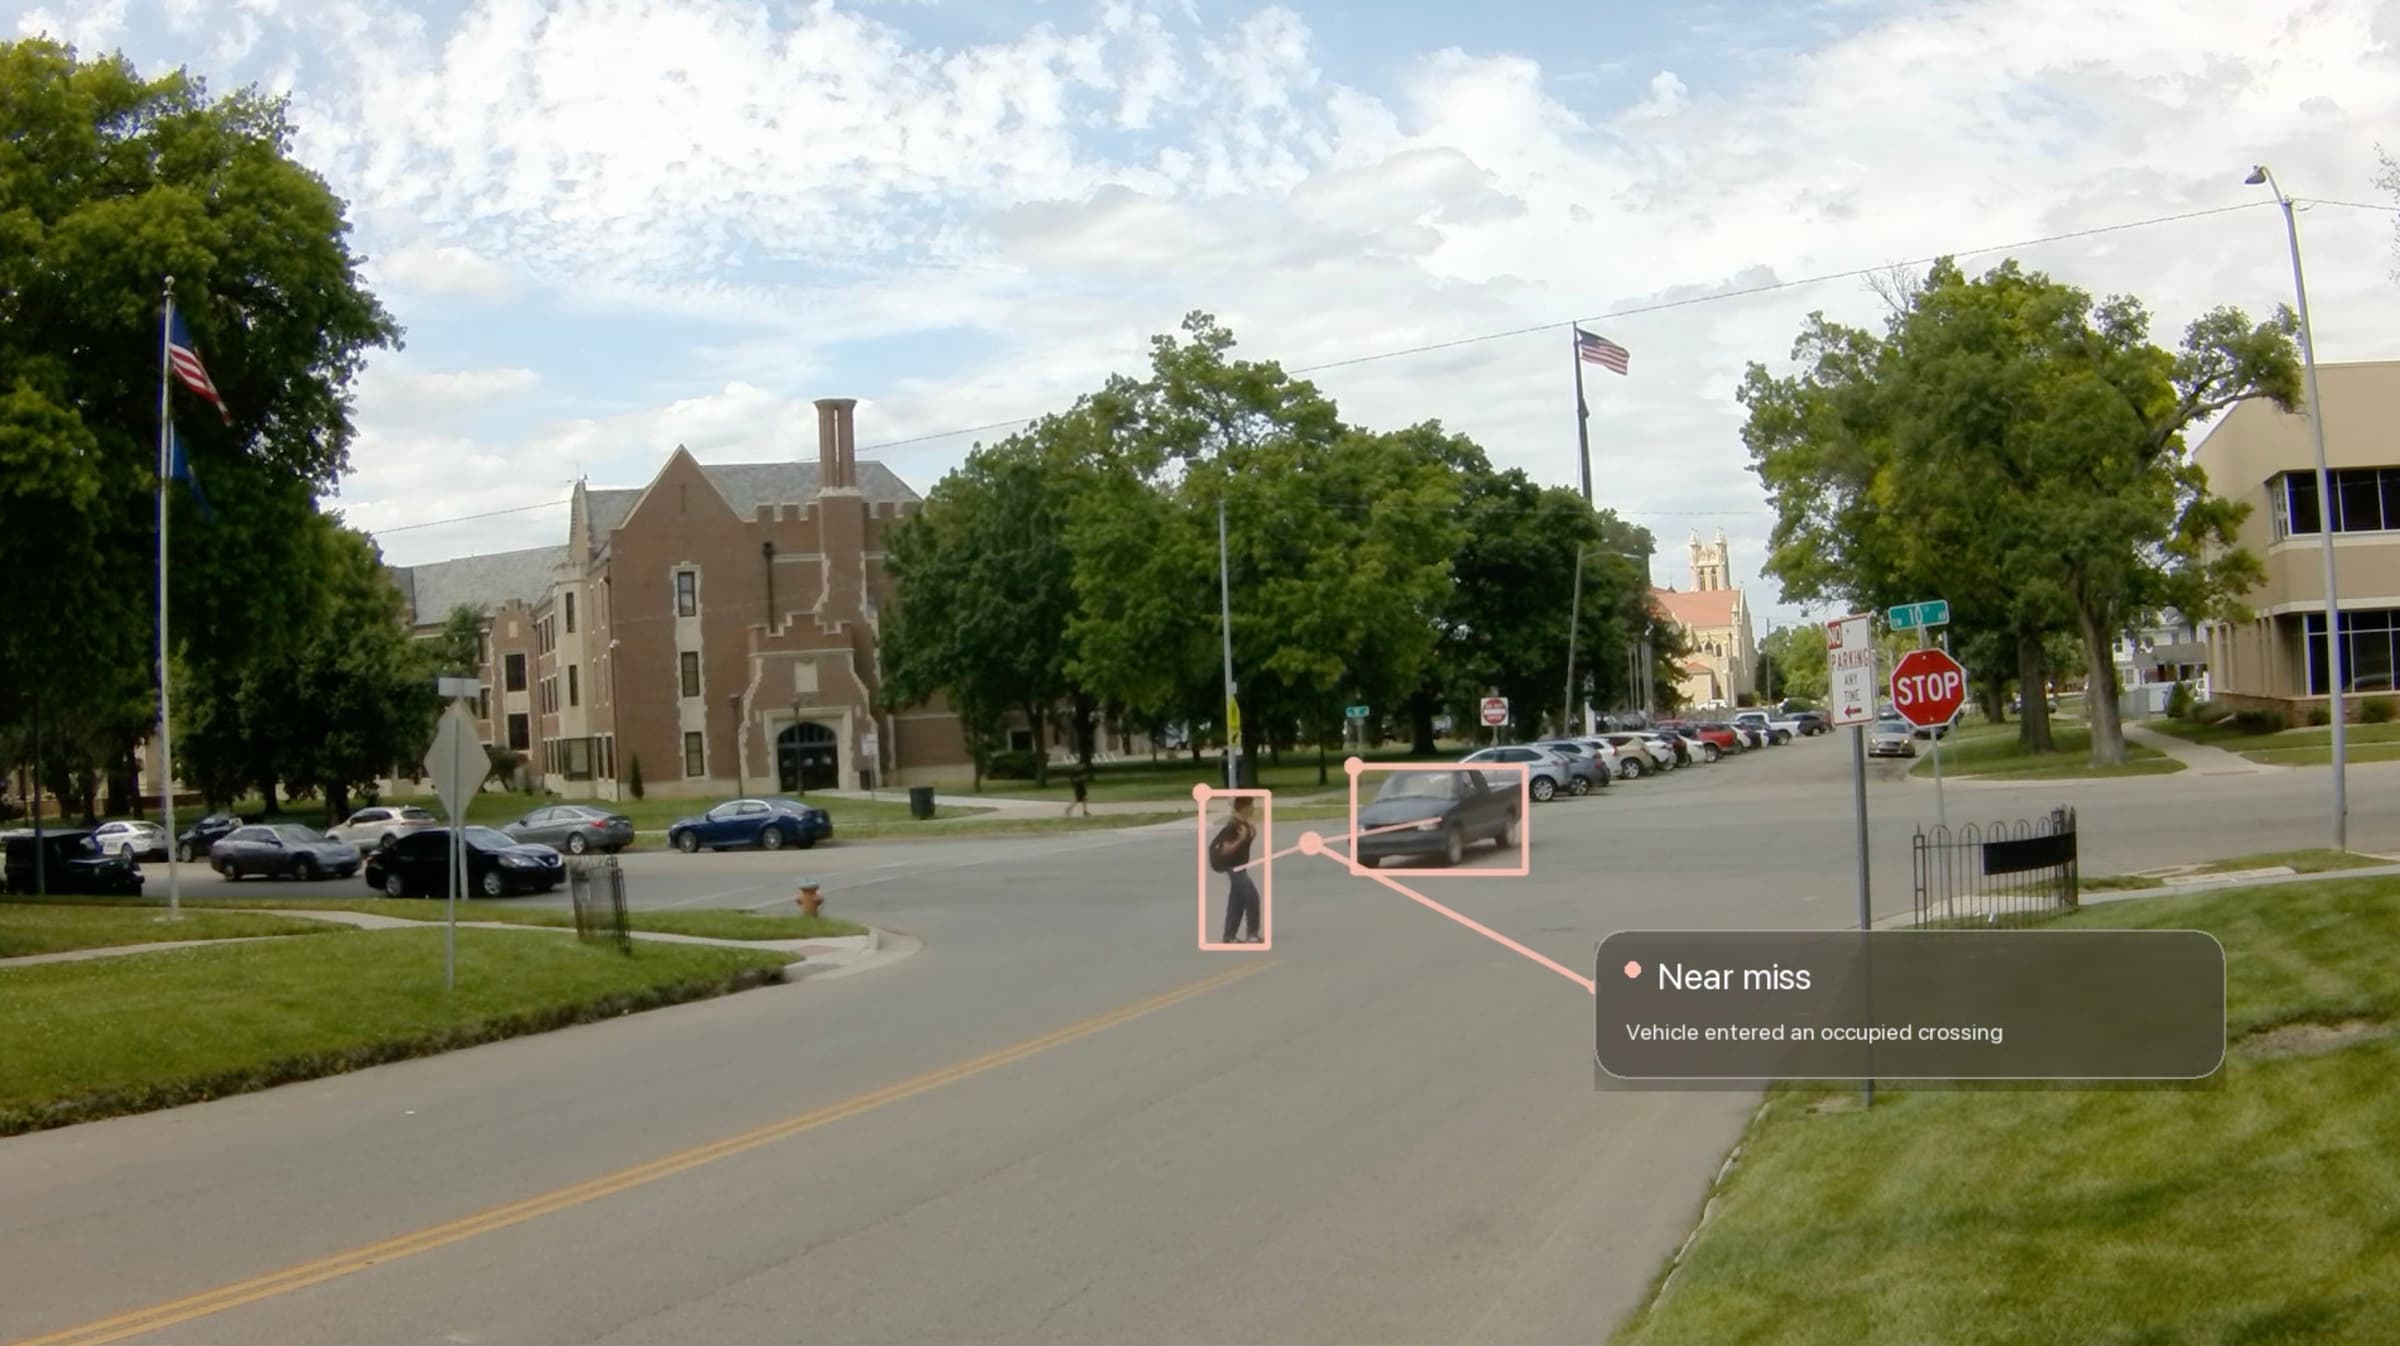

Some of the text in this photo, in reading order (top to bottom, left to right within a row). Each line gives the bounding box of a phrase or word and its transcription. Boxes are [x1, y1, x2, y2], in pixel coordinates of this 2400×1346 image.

[1829, 625, 1841, 646] NO
[1831, 648, 1870, 672] PARKING
[1844, 673, 1857, 686] ANY
[1897, 671, 1959, 706] STOP
